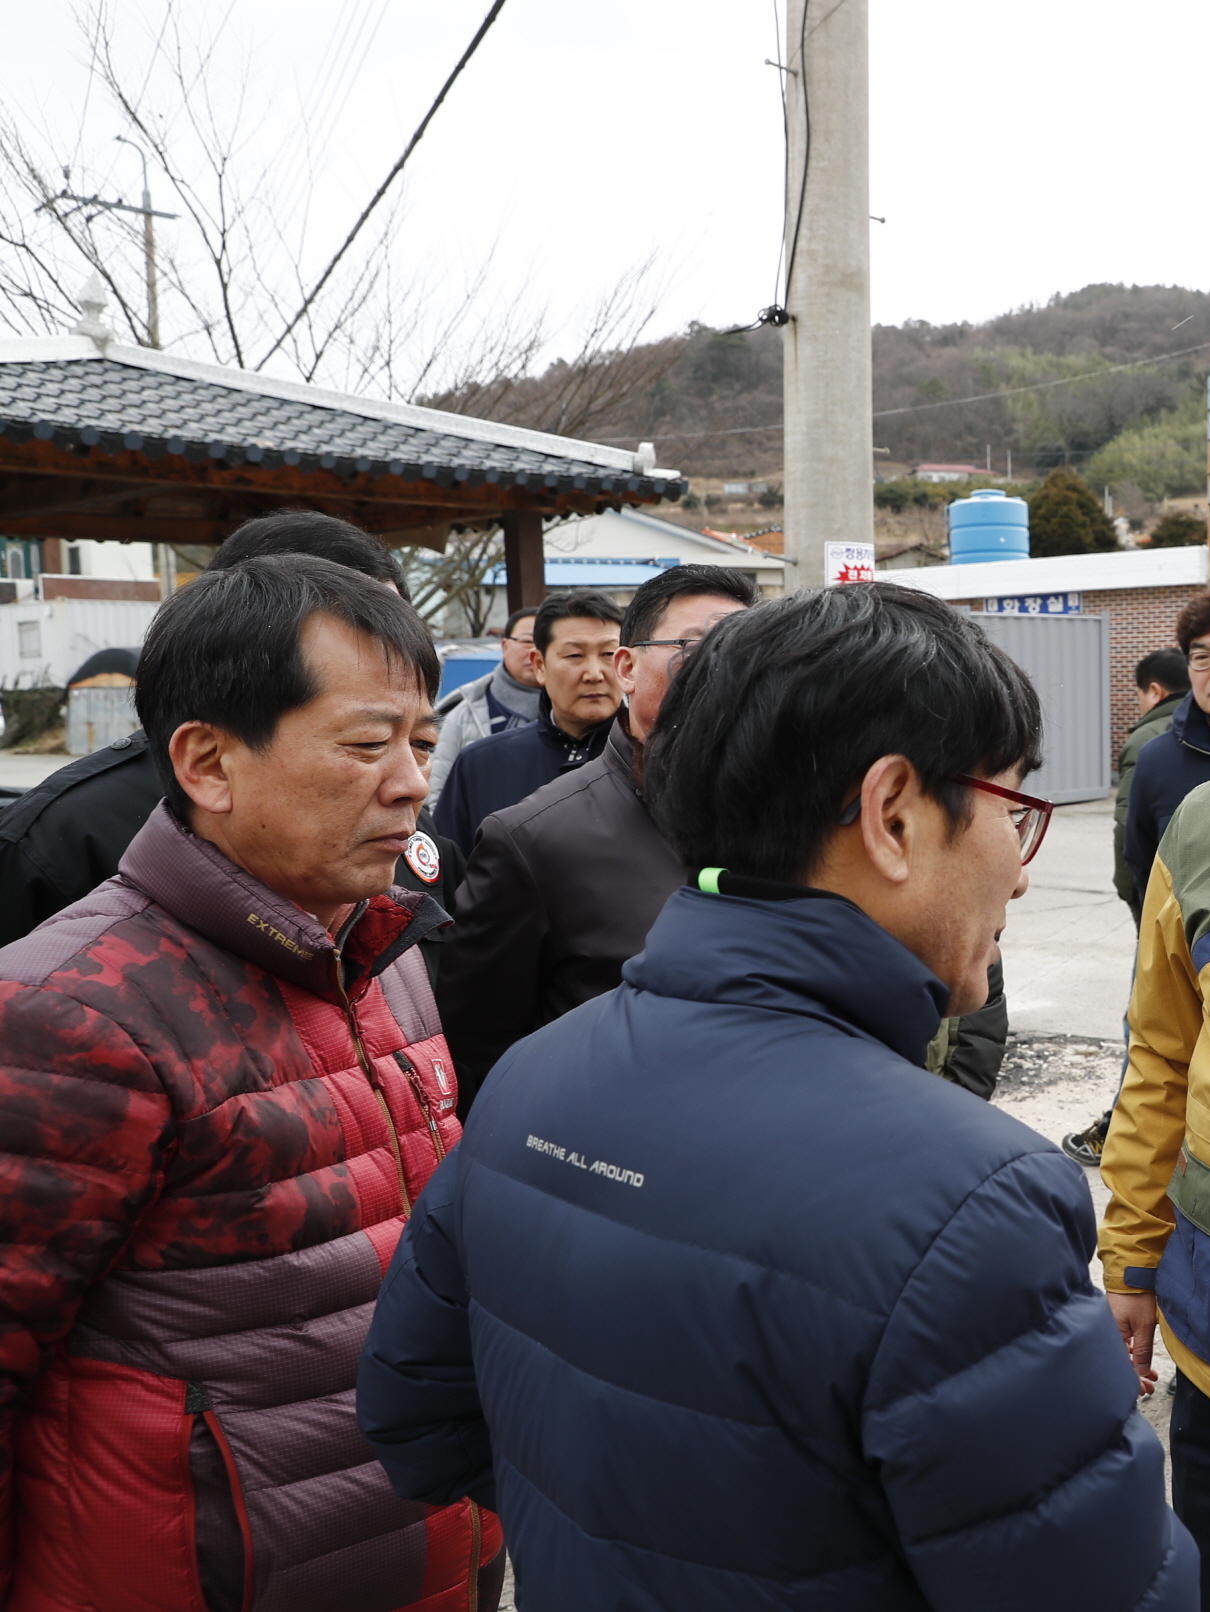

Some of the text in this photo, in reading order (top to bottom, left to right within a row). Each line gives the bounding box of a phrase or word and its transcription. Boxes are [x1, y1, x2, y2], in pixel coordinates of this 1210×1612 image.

[1002, 594, 1064, 615] 화장실
[246, 913, 315, 960] EXTREME
[526, 1134, 645, 1188] BREATHE ALL AROUND
